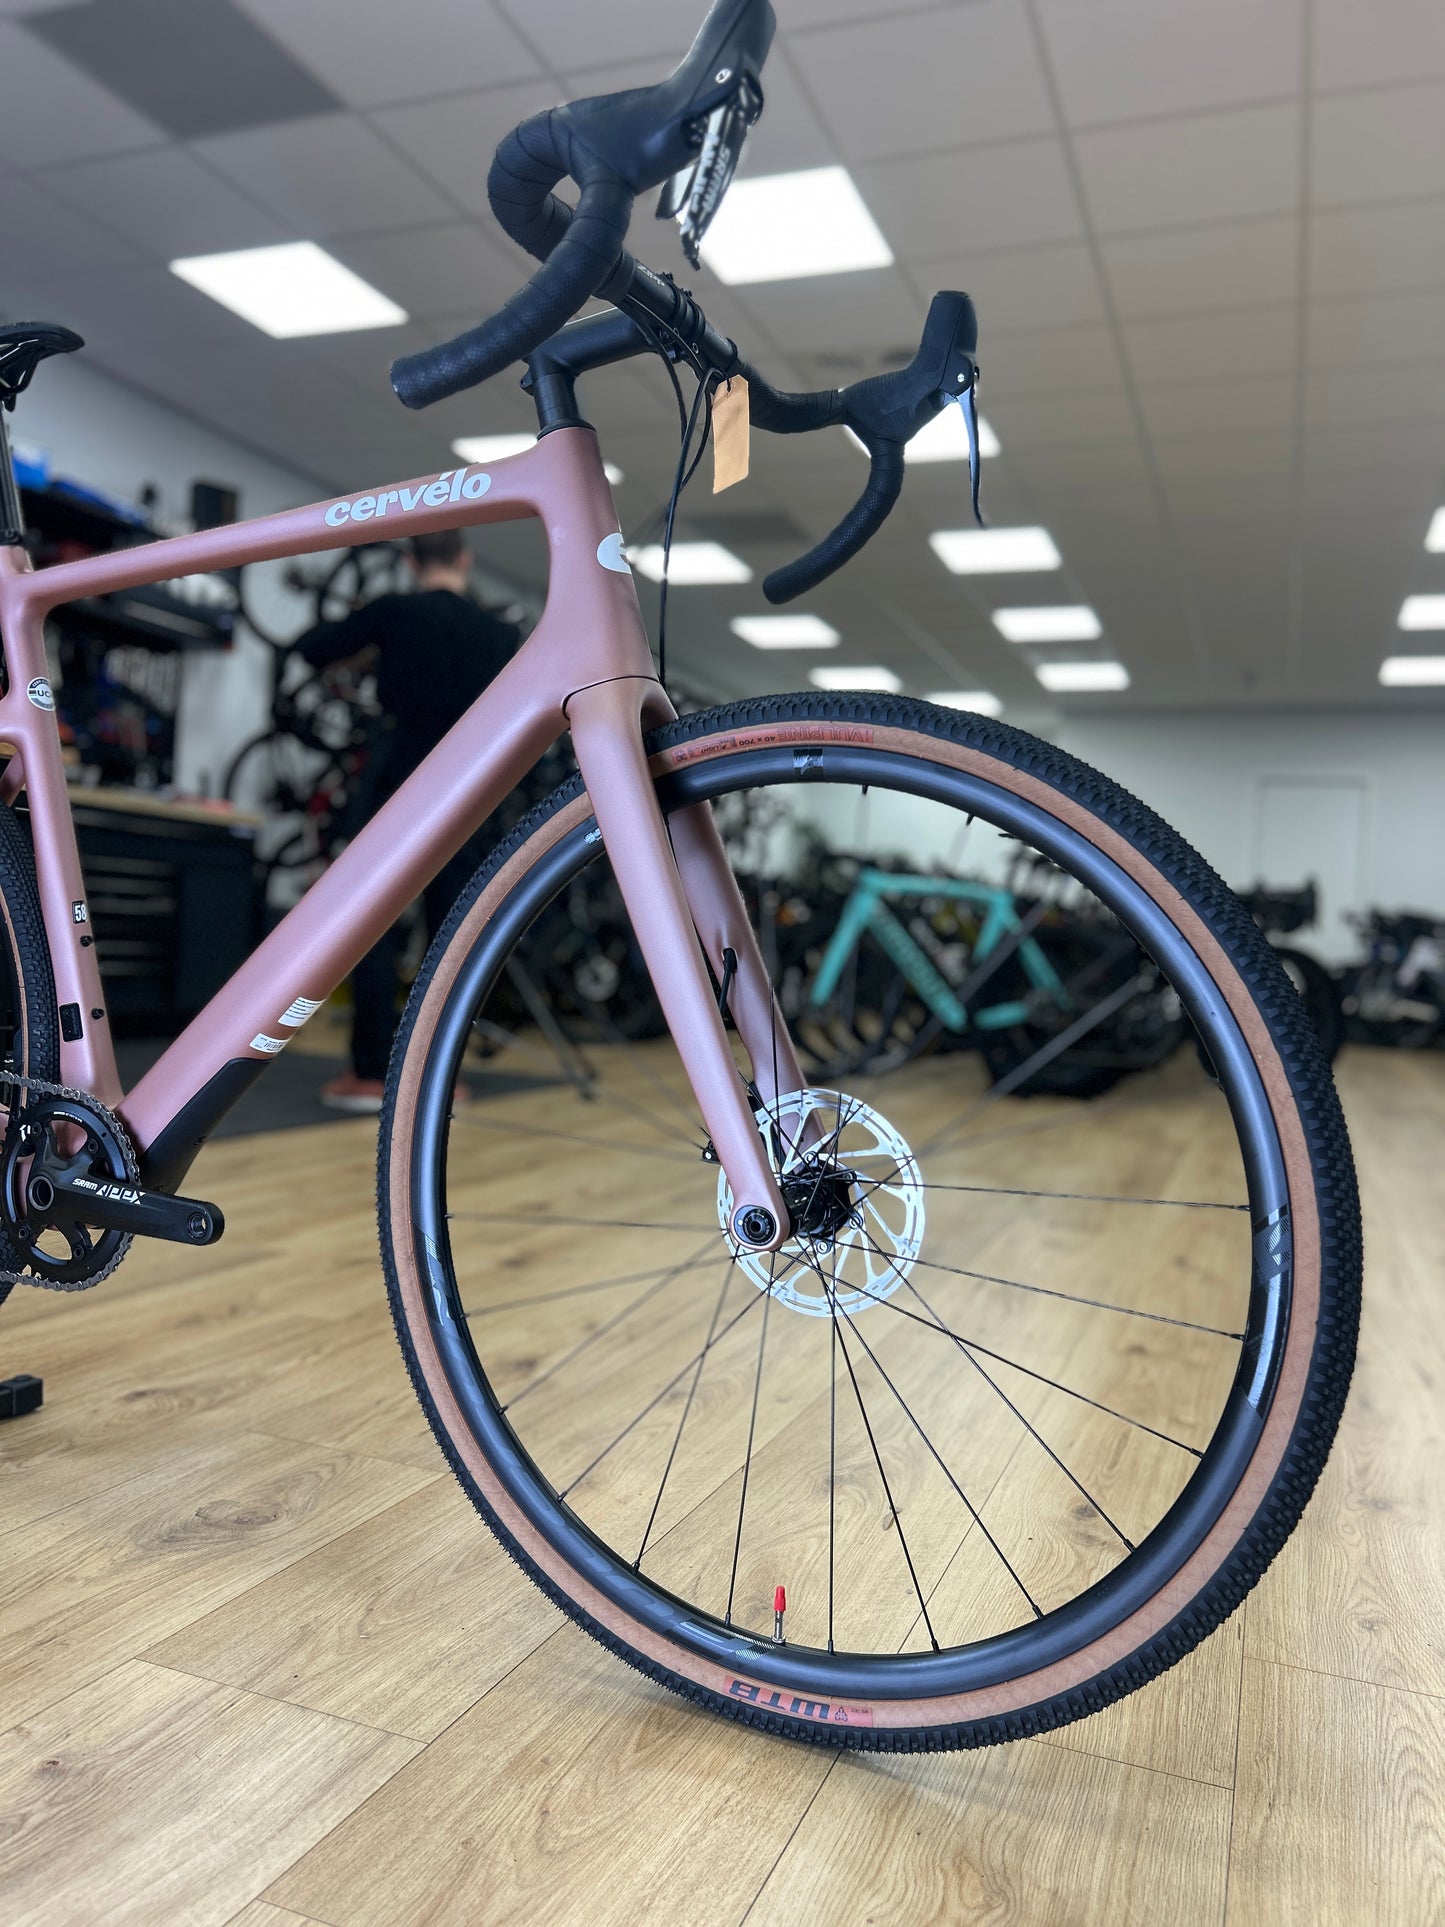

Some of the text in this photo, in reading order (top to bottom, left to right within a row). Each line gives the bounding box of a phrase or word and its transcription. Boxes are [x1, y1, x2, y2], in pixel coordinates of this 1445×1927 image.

[324, 467, 492, 527] cervélo
[776, 725, 865, 744] VULPINE
[74, 903, 87, 922] 58
[72, 1178, 98, 1191] SRAM
[729, 1680, 830, 1719] WTB
